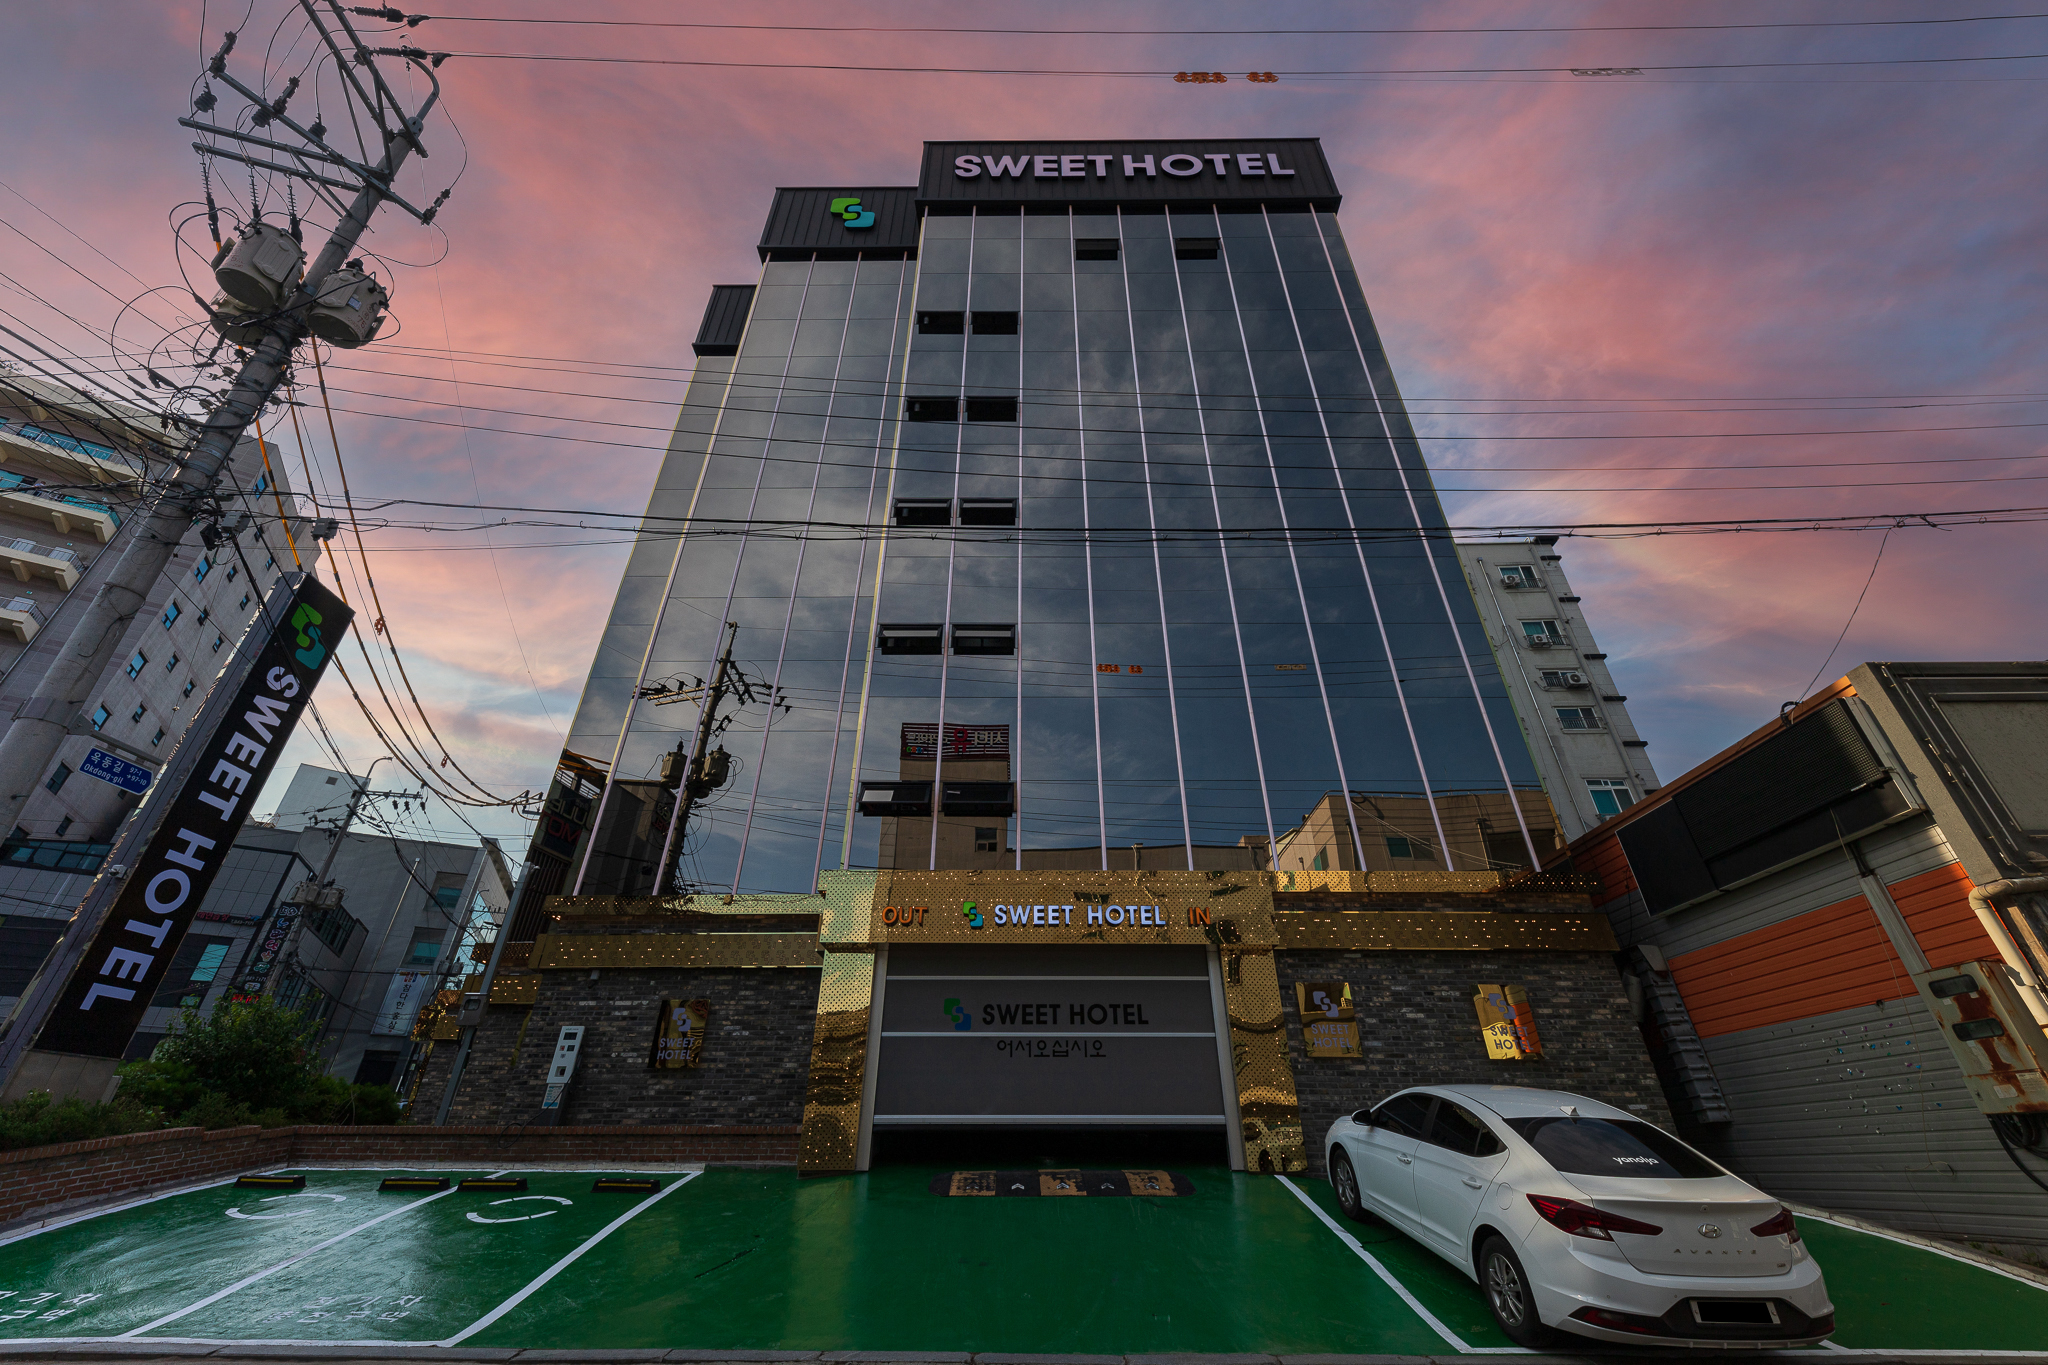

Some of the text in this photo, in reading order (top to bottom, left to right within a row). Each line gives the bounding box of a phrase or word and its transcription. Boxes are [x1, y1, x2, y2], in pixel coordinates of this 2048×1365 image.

[954, 152, 1296, 178] SWEET HOTEL
[90, 751, 143, 776] 옥동길 97-1
[83, 763, 124, 785] Okdong-gil
[79, 665, 300, 1012] SWEET HOTEL
[881, 906, 928, 926] OUT
[994, 904, 1166, 926] SWEET HOTEL
[1188, 907, 1212, 926] IN
[982, 1003, 1149, 1026] SWEET HOTEL
[1311, 1023, 1349, 1035] SWEET
[1490, 1026, 1528, 1037] SWEET
[660, 1037, 695, 1048] SWEET
[996, 1039, 1107, 1058] 어서오십시오
[1313, 1037, 1353, 1048] HOTEL
[1494, 1039, 1534, 1050] HOTEL
[656, 1050, 692, 1060] HOTEL
